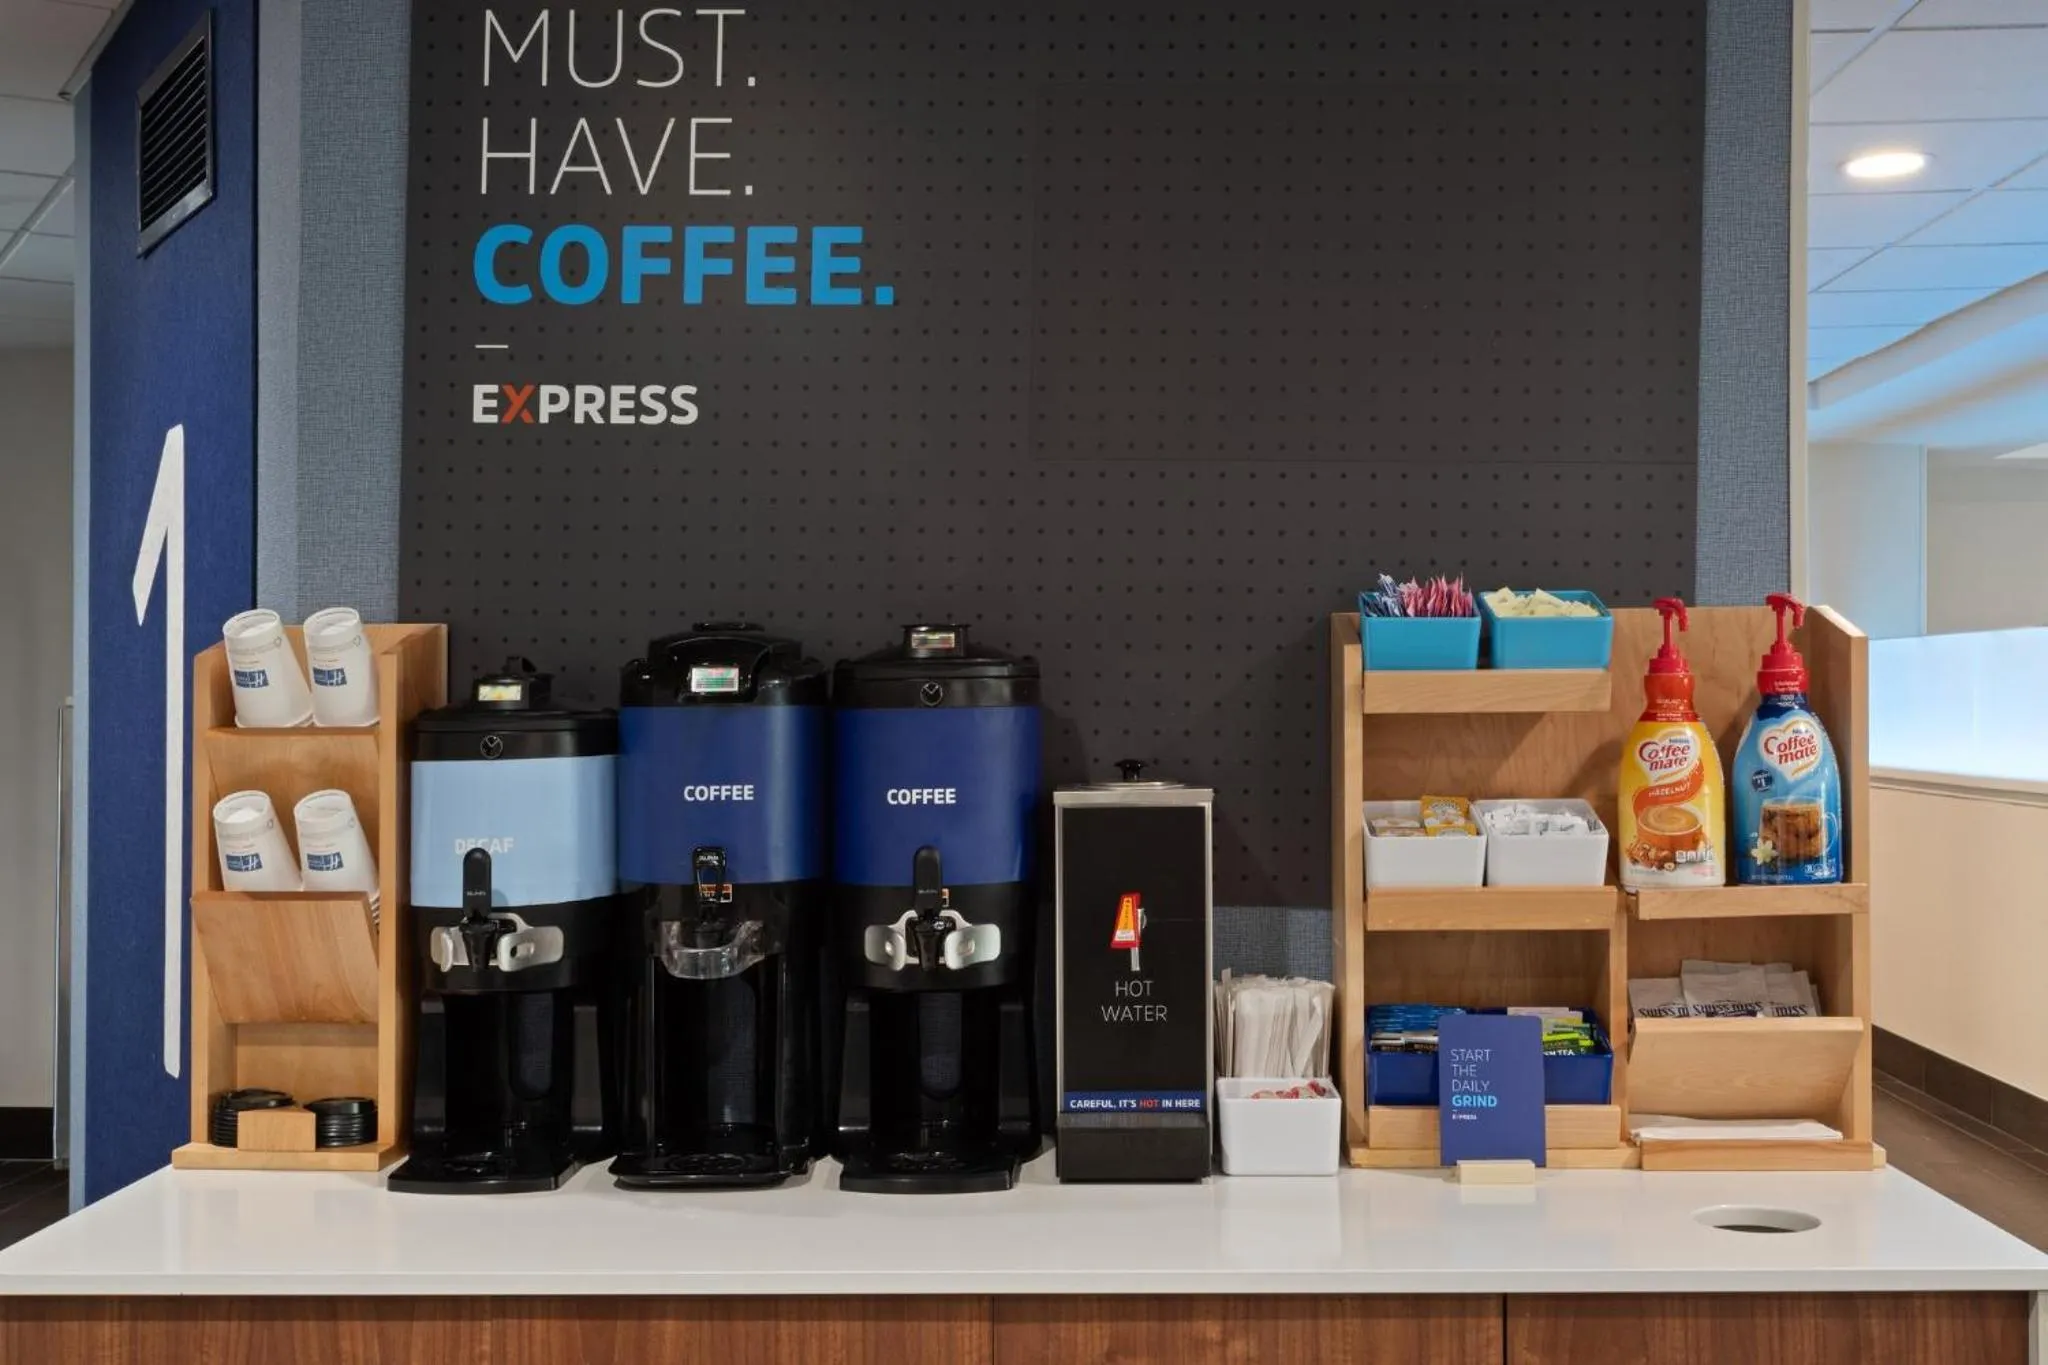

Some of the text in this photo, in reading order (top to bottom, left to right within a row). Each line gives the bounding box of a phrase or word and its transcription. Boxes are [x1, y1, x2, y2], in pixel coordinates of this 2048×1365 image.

[483, 8, 756, 88] MUST.
[481, 117, 753, 195] HAVE.
[473, 224, 894, 306] COFFEE.
[472, 384, 699, 425] EXPRESS
[1764, 734, 1815, 756] Coffee
[1778, 744, 1818, 765] mate
[683, 784, 754, 801] COFFEE
[887, 788, 957, 805] COFFEE
[1115, 980, 1154, 997] HOT
[1101, 1005, 1168, 1022] WATER
[1450, 1048, 1491, 1062] START
[1452, 1063, 1477, 1077] THE
[1452, 1079, 1490, 1093] DAILY
[1070, 1099, 1201, 1109] CAREFUL, IT'S HOT IN HERE
[1452, 1094, 1498, 1107] GRIND
